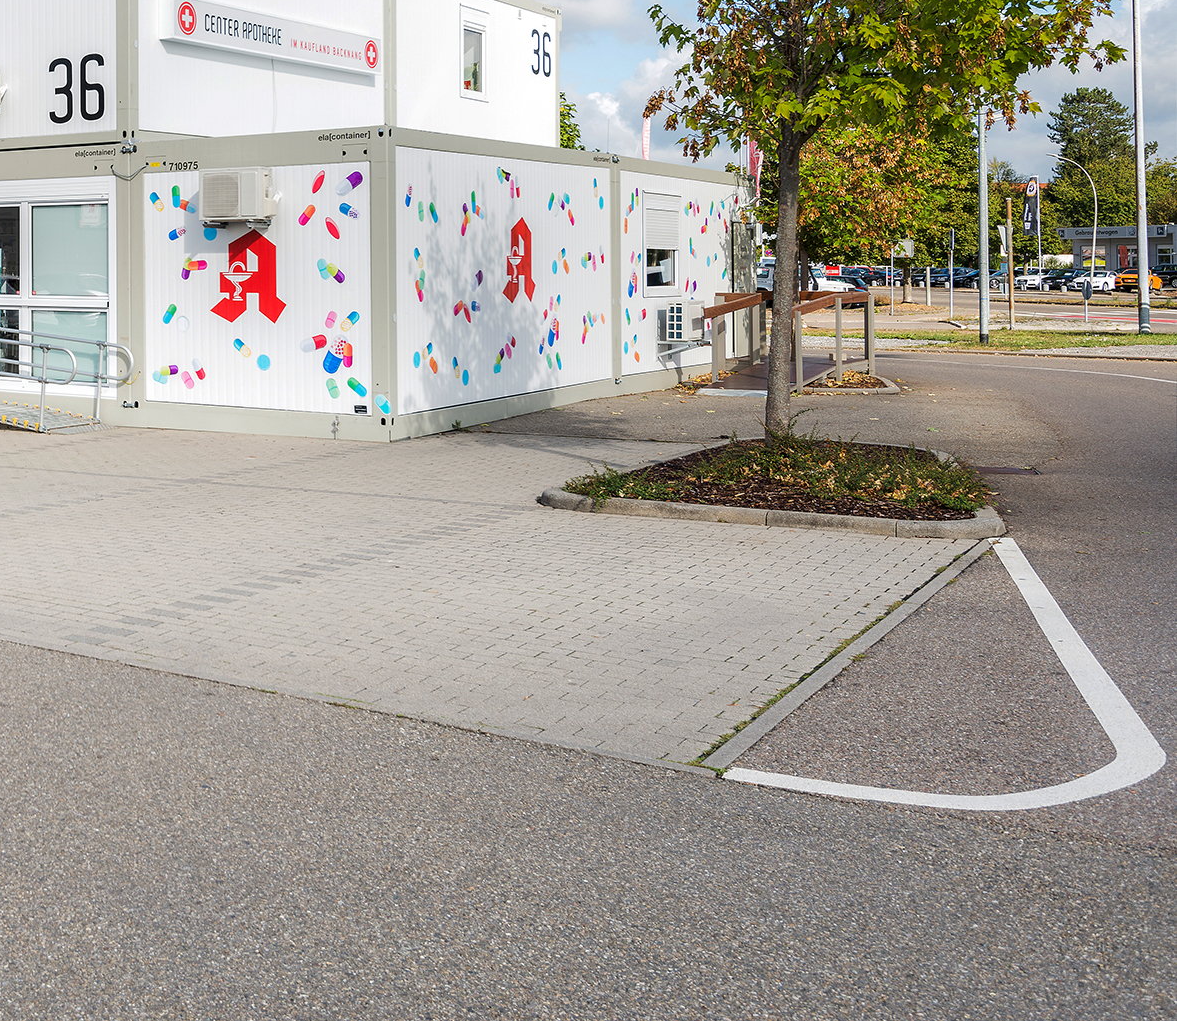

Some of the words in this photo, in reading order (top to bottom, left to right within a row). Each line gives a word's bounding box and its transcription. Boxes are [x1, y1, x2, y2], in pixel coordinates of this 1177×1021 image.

[203, 13, 240, 38] CENTER
[242, 21, 282, 46] APOTHEKE
[290, 38, 298, 49] IM
[300, 40, 331, 55] KAUFLAND
[333, 46, 362, 61] BACKNANG
[530, 28, 552, 78] 36
[48, 53, 106, 124] 36
[317, 130, 371, 142] ela[container]
[74, 148, 116, 158] ela[container]
[168, 161, 199, 171] 710975
